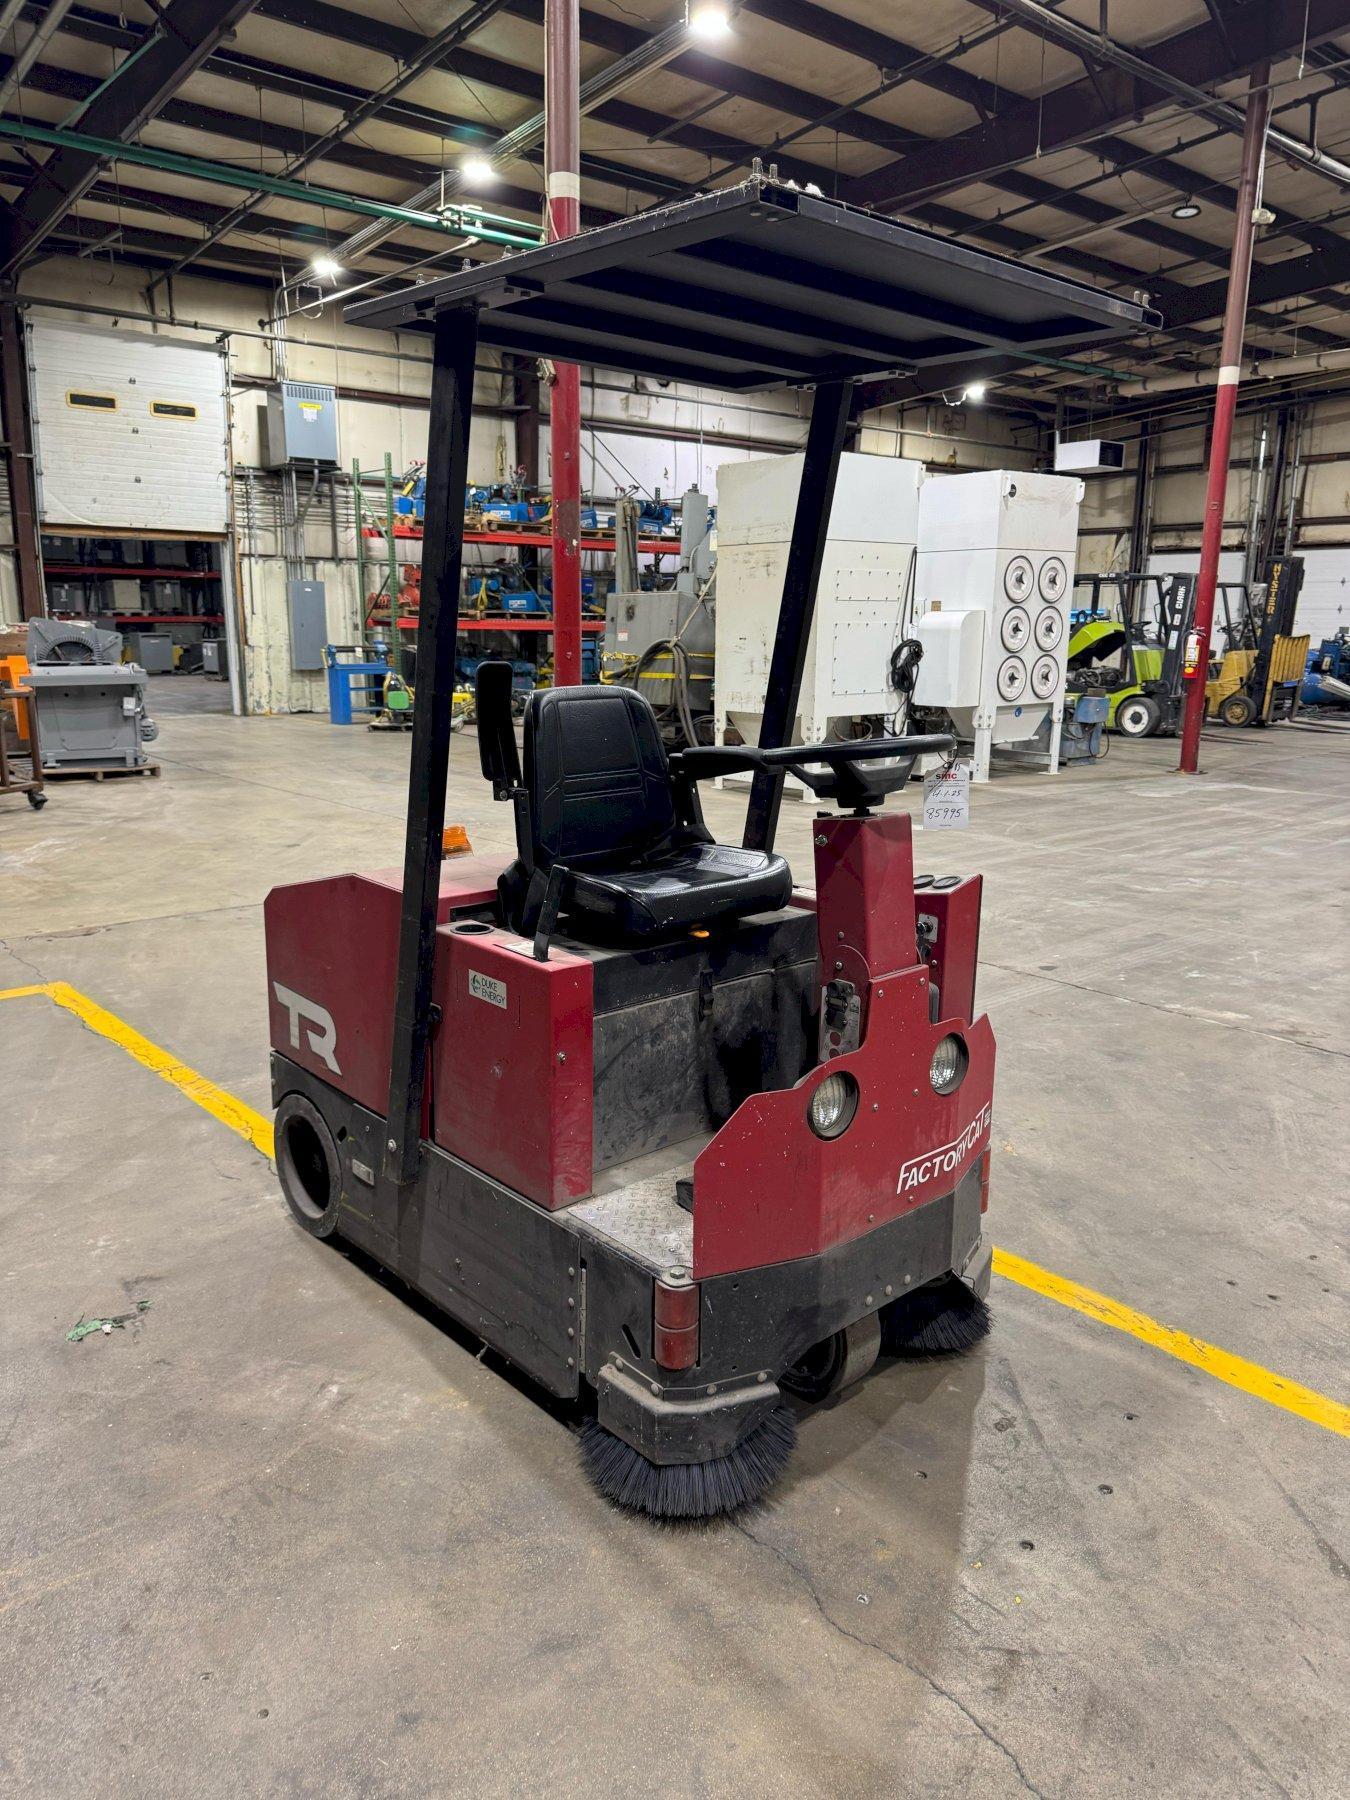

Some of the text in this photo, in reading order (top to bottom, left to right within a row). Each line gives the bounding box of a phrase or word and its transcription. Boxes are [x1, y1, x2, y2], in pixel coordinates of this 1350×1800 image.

[1175, 585, 1186, 609] CLARK
[1267, 563, 1282, 614] HYSTER
[926, 808, 964, 820] 85995
[481, 978, 498, 992] DUKE
[481, 988, 506, 1004] ENERGY
[273, 981, 342, 1076] TR
